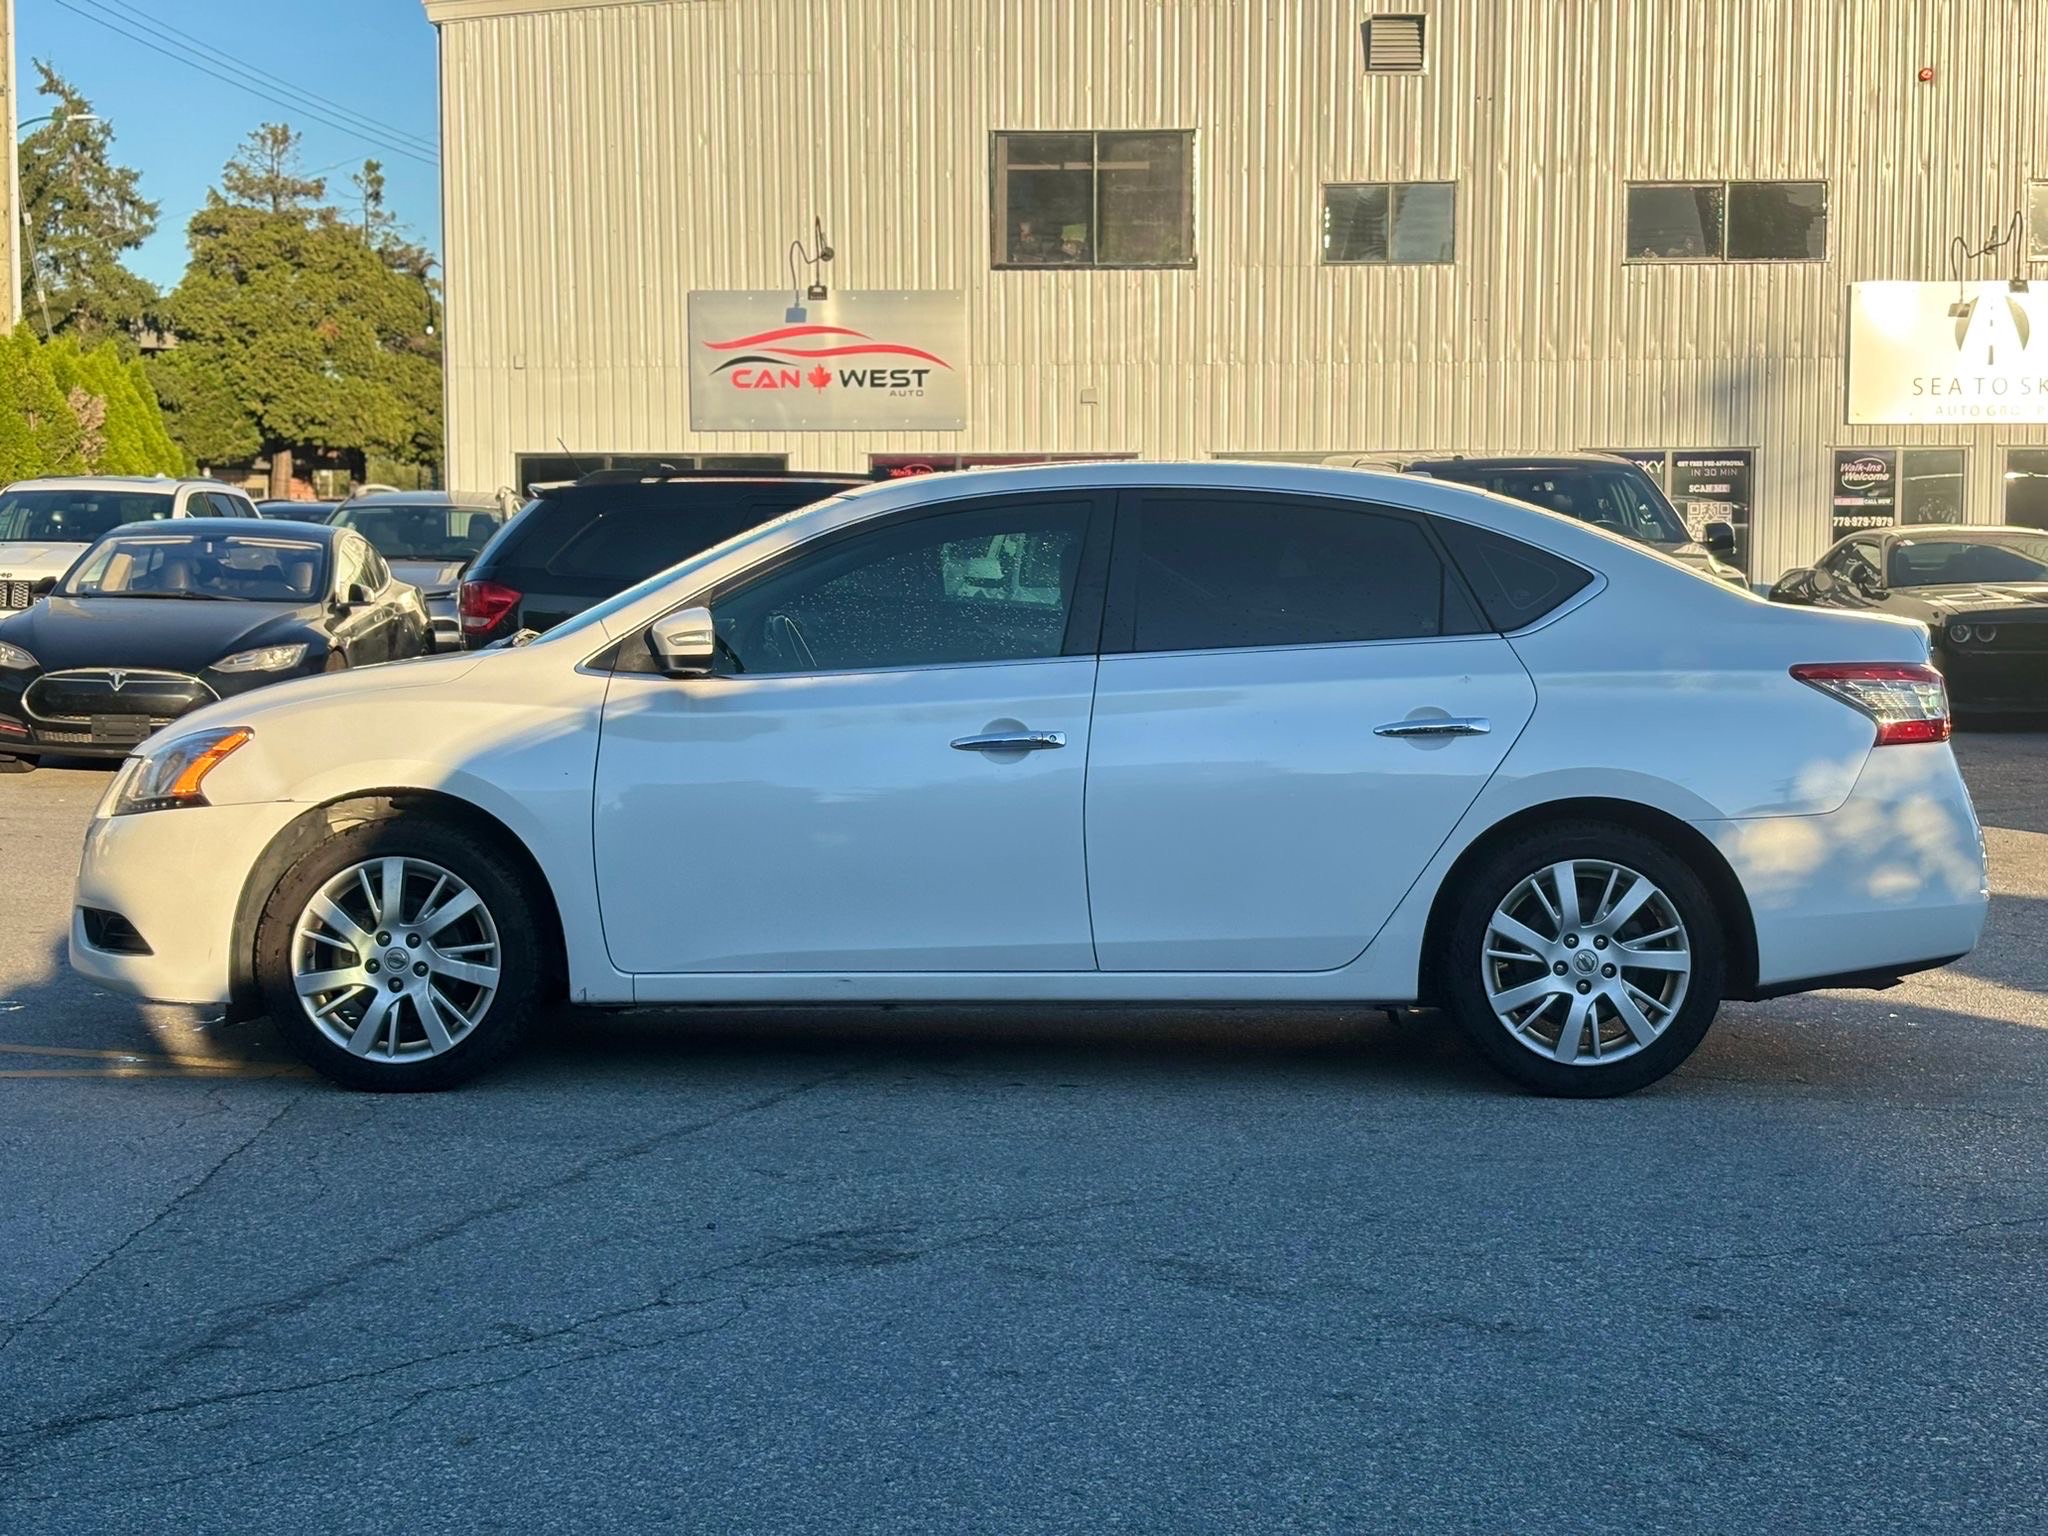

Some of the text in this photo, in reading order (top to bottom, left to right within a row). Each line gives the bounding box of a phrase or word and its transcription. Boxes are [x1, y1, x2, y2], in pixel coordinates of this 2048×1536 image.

[731, 369, 931, 389] CAN WEST
[1913, 377, 1962, 395] SEA
[1975, 377, 2008, 395] TO
[1691, 468, 1738, 477] IN 30 MIN
[1840, 463, 1882, 473] Walk-Ins
[1844, 472, 1889, 481] Welcome
